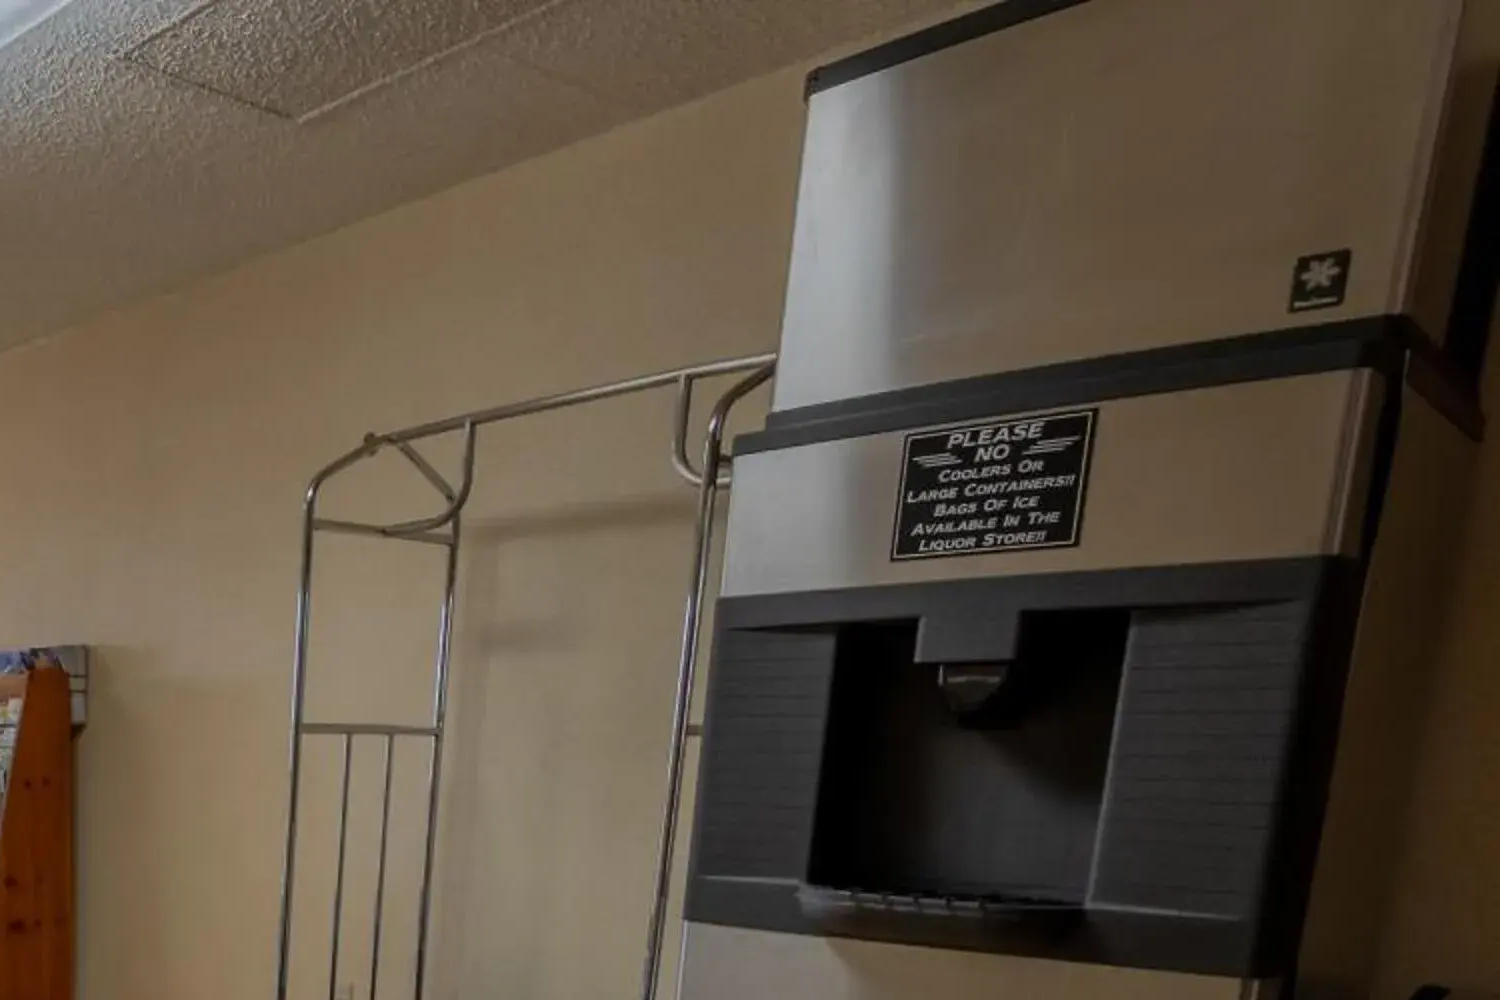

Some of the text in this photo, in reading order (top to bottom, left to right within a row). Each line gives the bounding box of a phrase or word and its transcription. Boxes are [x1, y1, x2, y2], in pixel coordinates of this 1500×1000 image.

[948, 421, 1045, 449] PLEASE
[974, 444, 1010, 463] NO
[938, 459, 1044, 483] COOLERS OR
[907, 488, 958, 503] LARGE
[933, 496, 1040, 517] BAGS OF ICE
[911, 512, 1060, 536] AVAILABLE IN THE
[919, 535, 976, 551] LIQUOR
